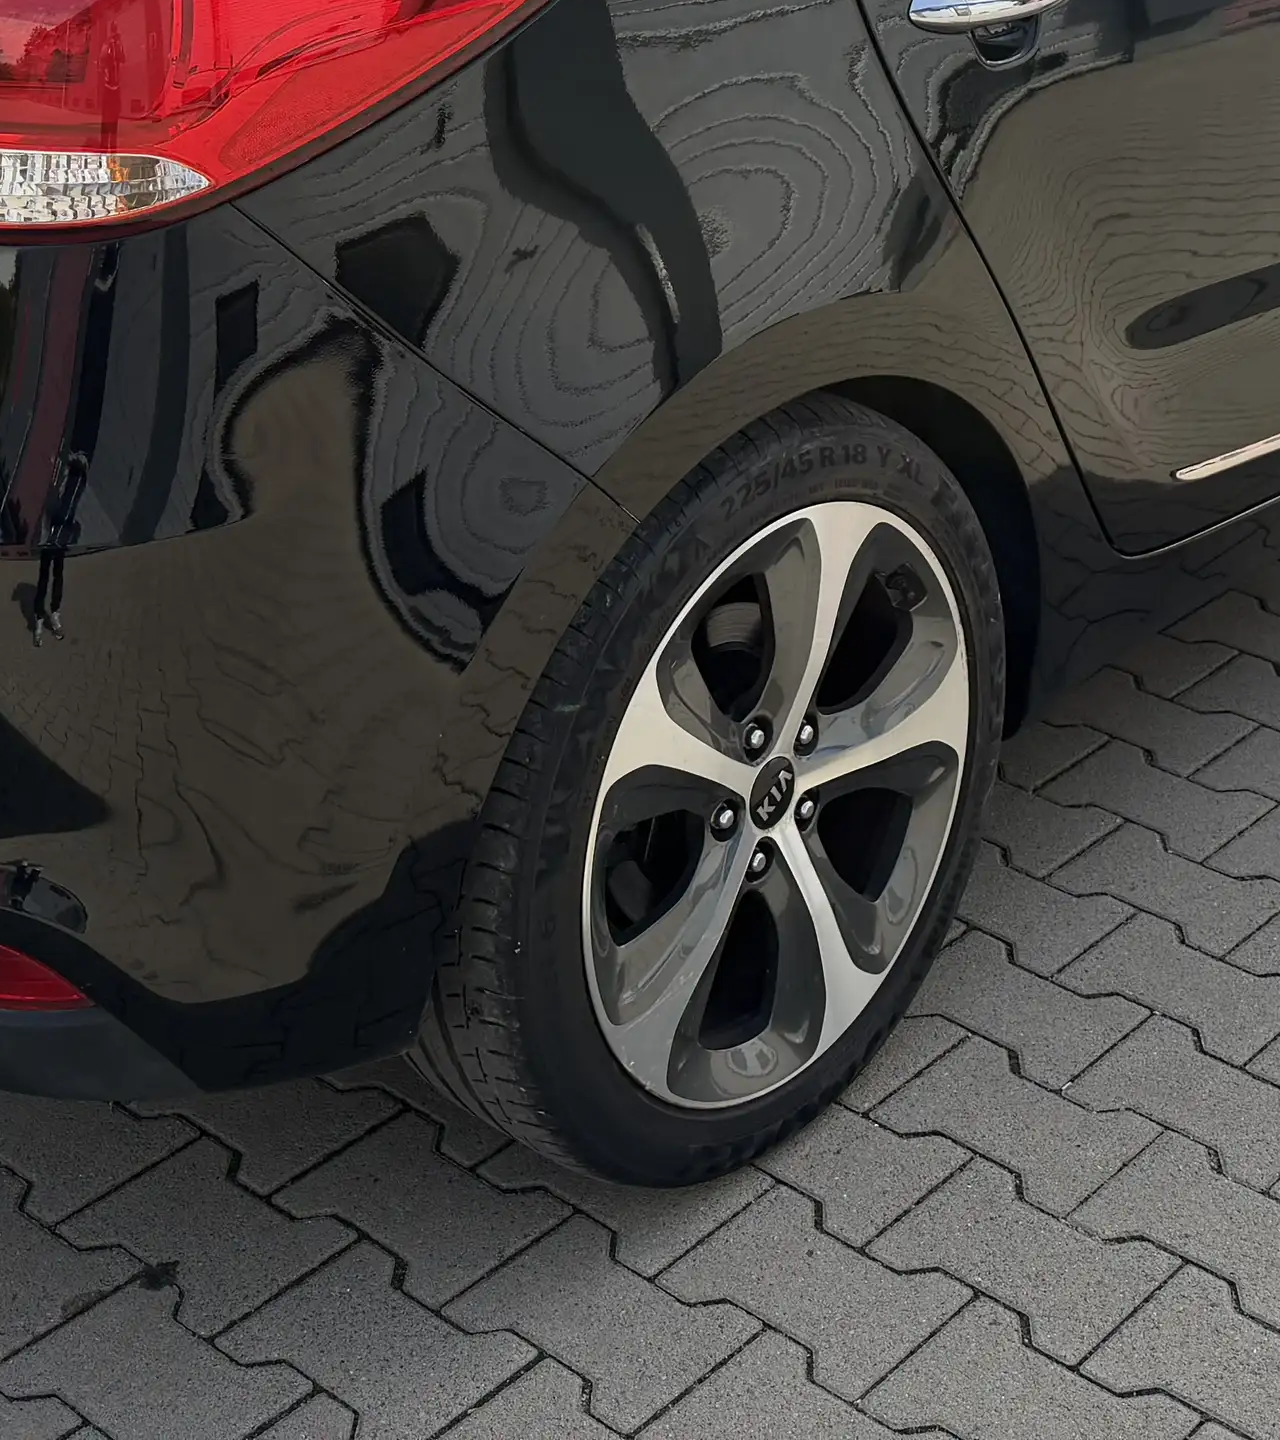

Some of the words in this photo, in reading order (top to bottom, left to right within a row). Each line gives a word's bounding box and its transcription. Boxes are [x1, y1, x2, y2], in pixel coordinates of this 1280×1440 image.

[720, 451, 815, 520] 225/45
[876, 446, 892, 468] Y
[756, 770, 793, 822] KIA
